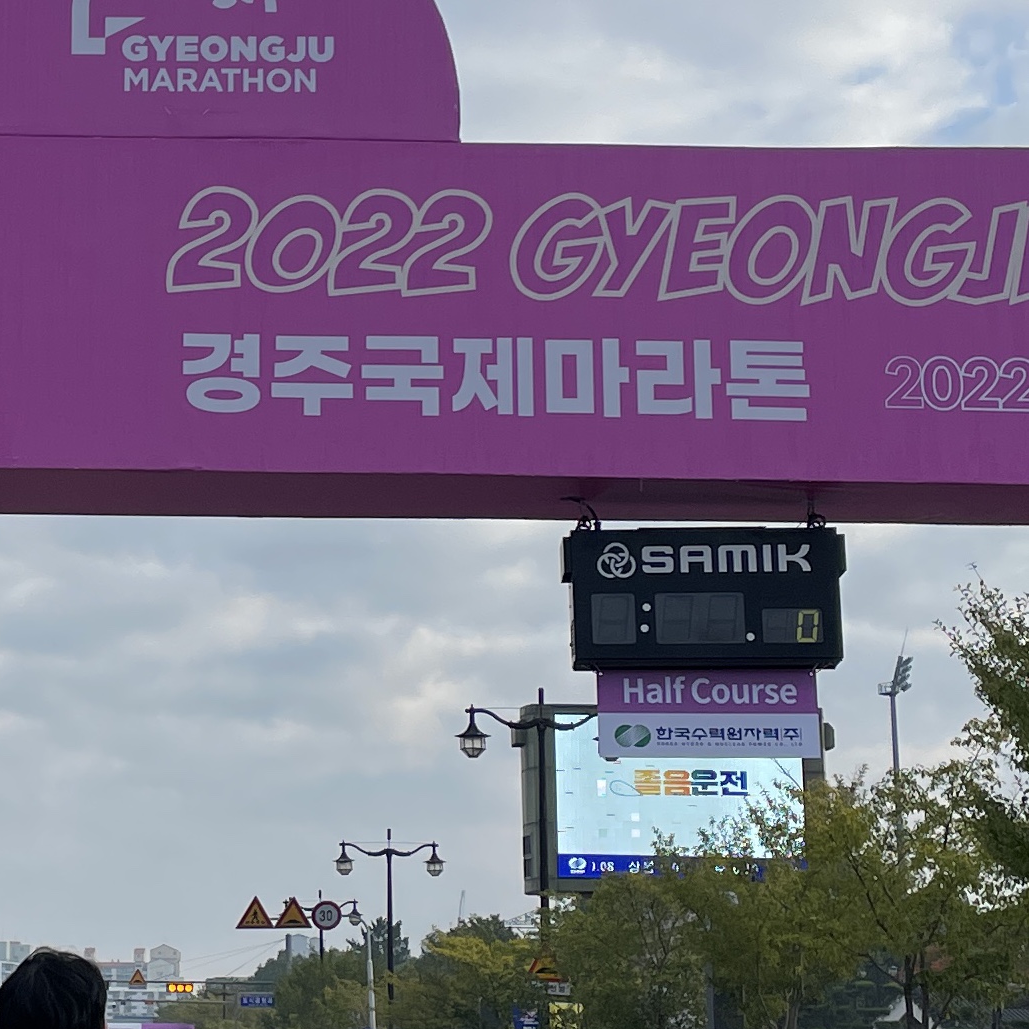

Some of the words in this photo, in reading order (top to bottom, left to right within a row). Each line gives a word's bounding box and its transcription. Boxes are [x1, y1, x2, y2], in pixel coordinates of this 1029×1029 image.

[122, 35, 335, 63] GYEONGJU
[123, 67, 317, 93] MARATHON
[165, 185, 493, 298] 2022
[509, 191, 1029, 308] GYEONGJ
[181, 332, 811, 422] 경주국제마라톤
[884, 355, 1029, 411] 2022
[640, 543, 813, 574] SAMIK
[622, 677, 685, 705] Half
[691, 678, 798, 705] Course
[319, 910, 333, 922] 30
